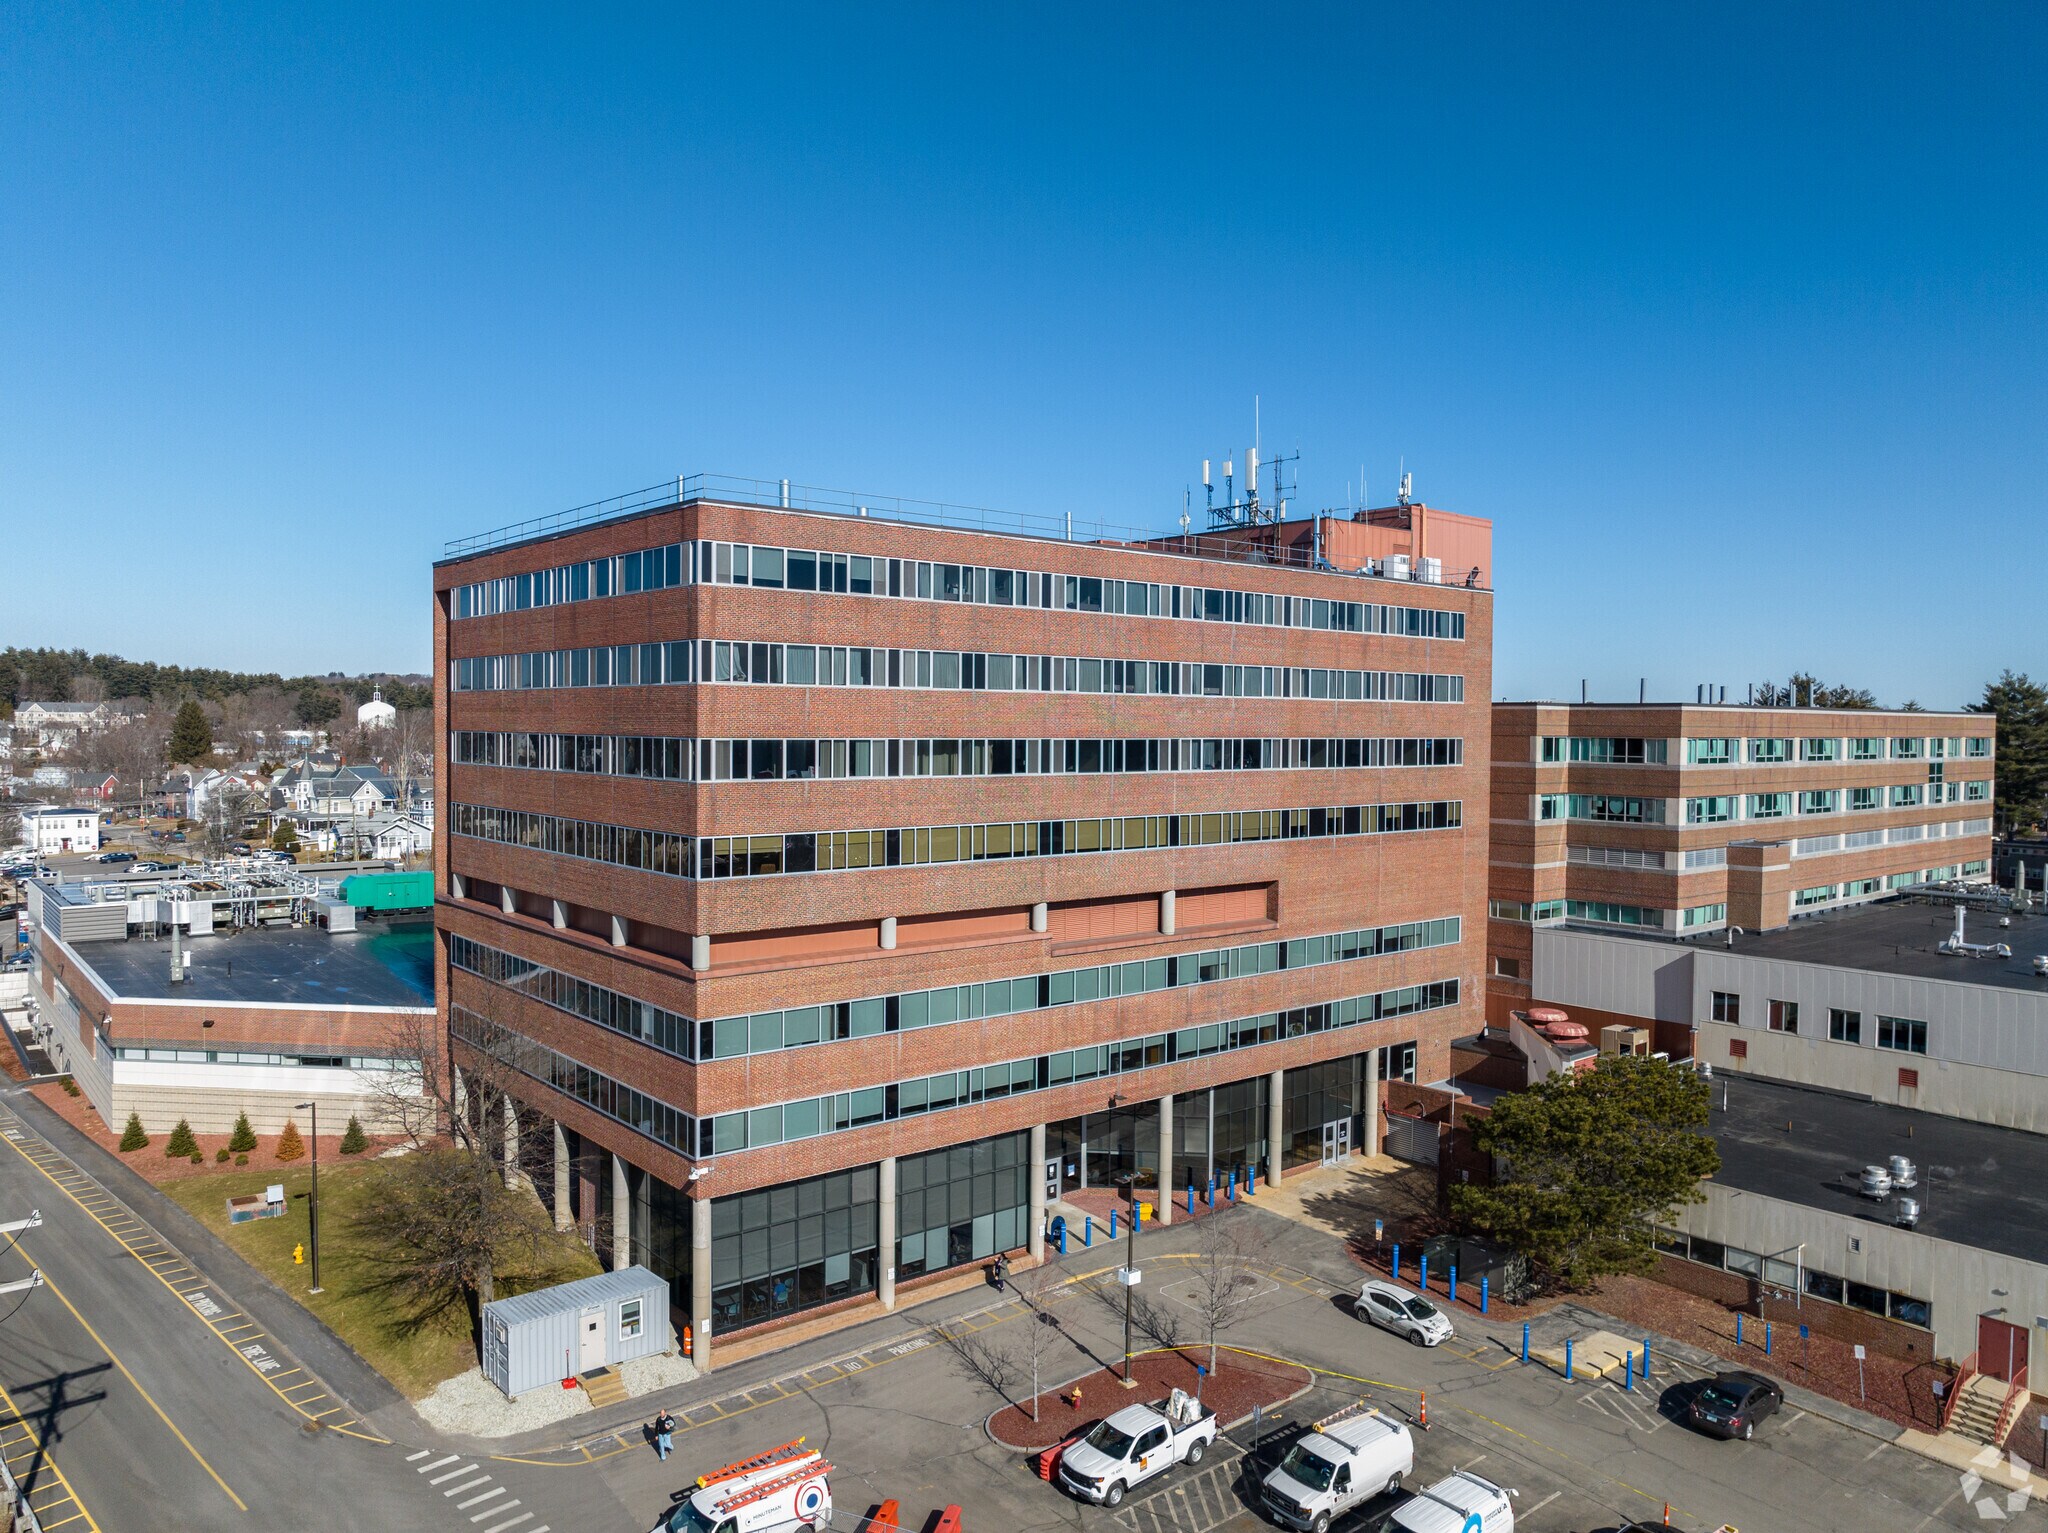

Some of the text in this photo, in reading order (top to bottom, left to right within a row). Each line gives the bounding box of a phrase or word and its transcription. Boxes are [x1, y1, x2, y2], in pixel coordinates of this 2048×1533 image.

[240, 1344, 280, 1373] FIRE LANE
[843, 1338, 930, 1372] NO PARKING
[752, 1505, 782, 1520] MINUTEMAN
